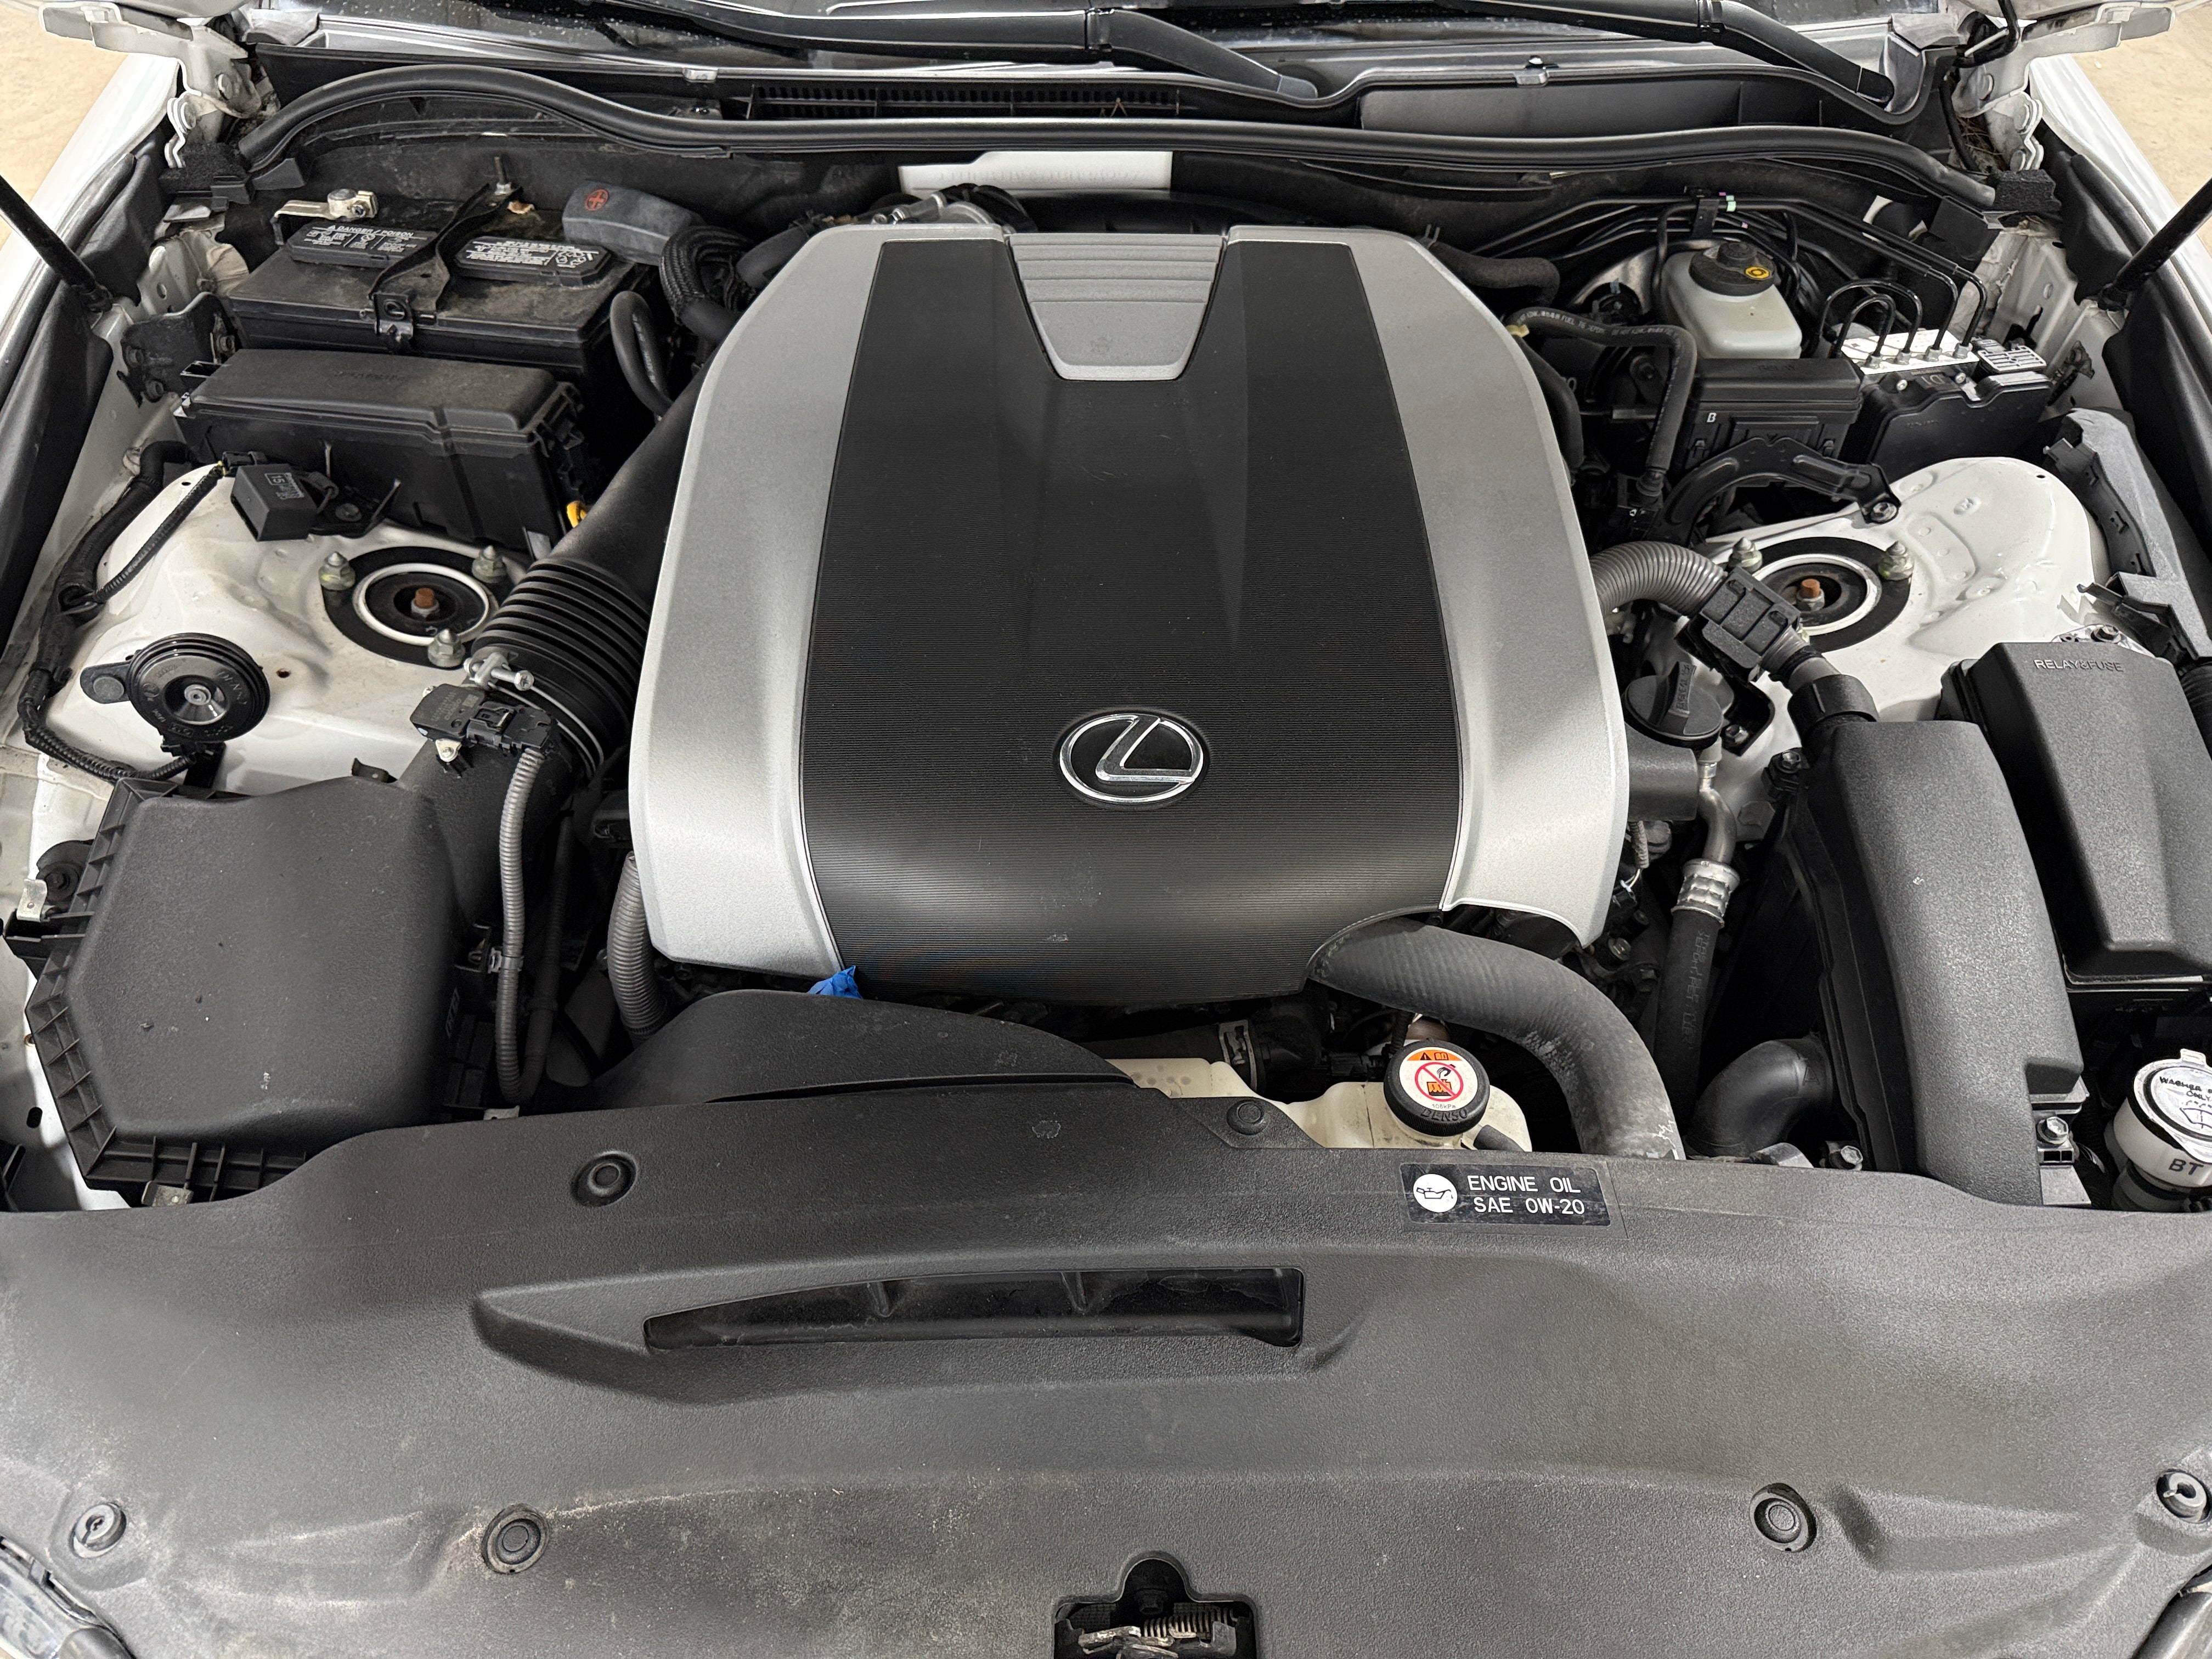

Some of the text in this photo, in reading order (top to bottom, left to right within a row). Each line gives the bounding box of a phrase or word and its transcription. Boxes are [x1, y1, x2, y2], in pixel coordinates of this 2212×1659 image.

[2033, 659, 2124, 673] RELAY&FUSE
[1421, 1107, 1468, 1122] DENSO
[1467, 1175, 1581, 1193] ENGINE OIL
[1473, 1196, 1585, 1215] SAE 0W-20
